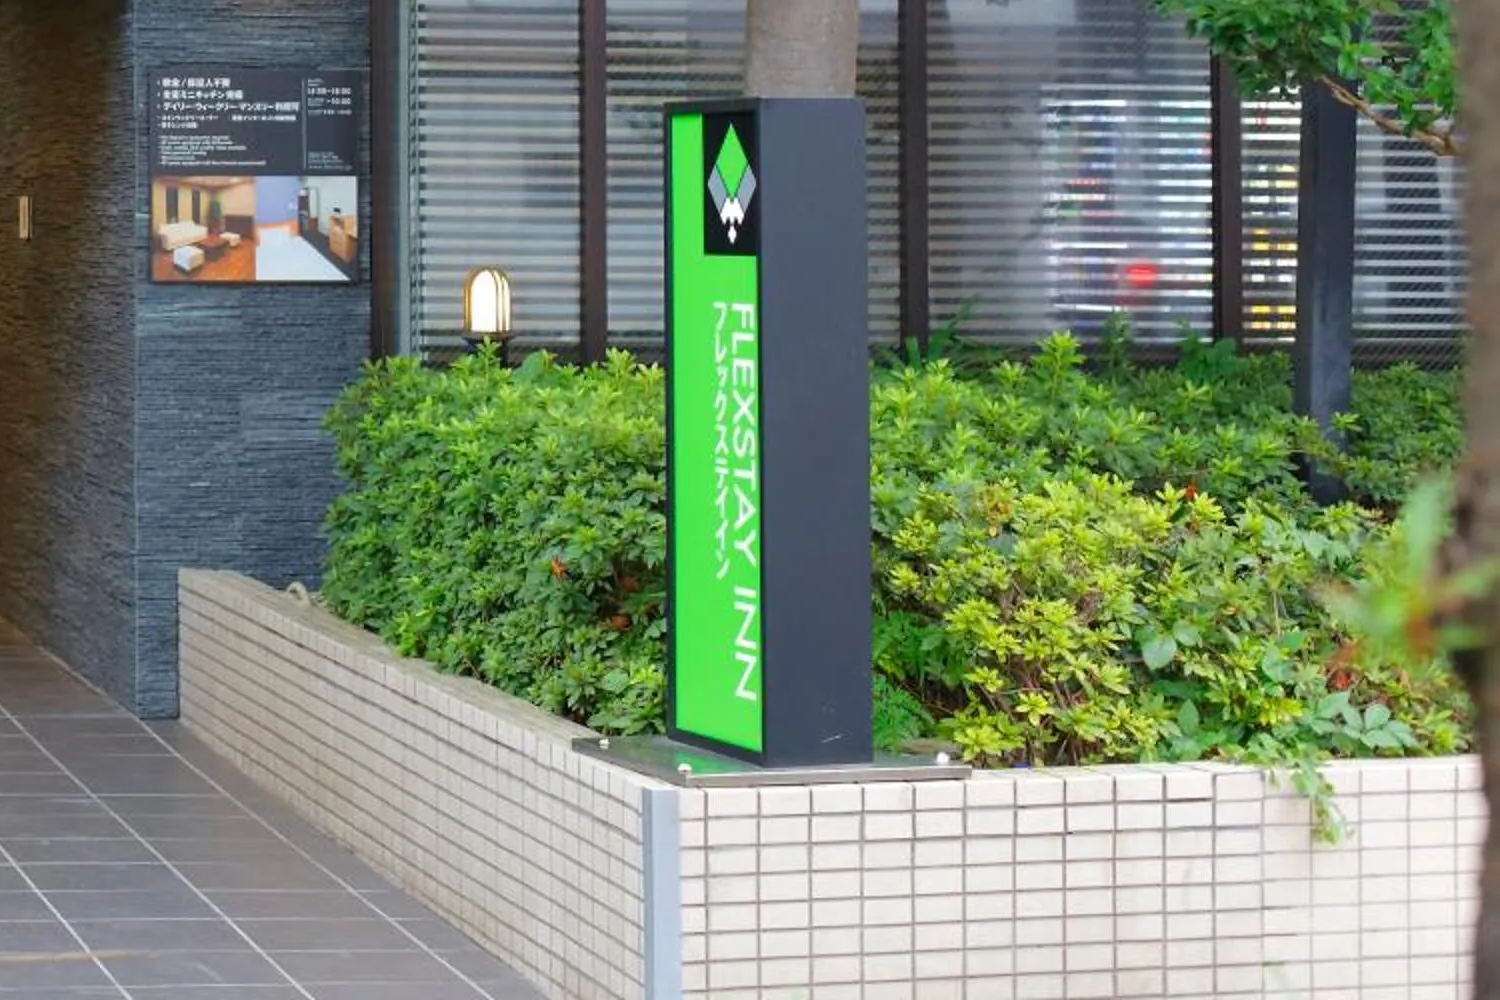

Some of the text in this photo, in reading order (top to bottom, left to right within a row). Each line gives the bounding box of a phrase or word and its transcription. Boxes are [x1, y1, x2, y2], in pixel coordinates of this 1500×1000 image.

[712, 301, 730, 580] フレックステイイン
[730, 302, 757, 701] FLEXSTAY INN
